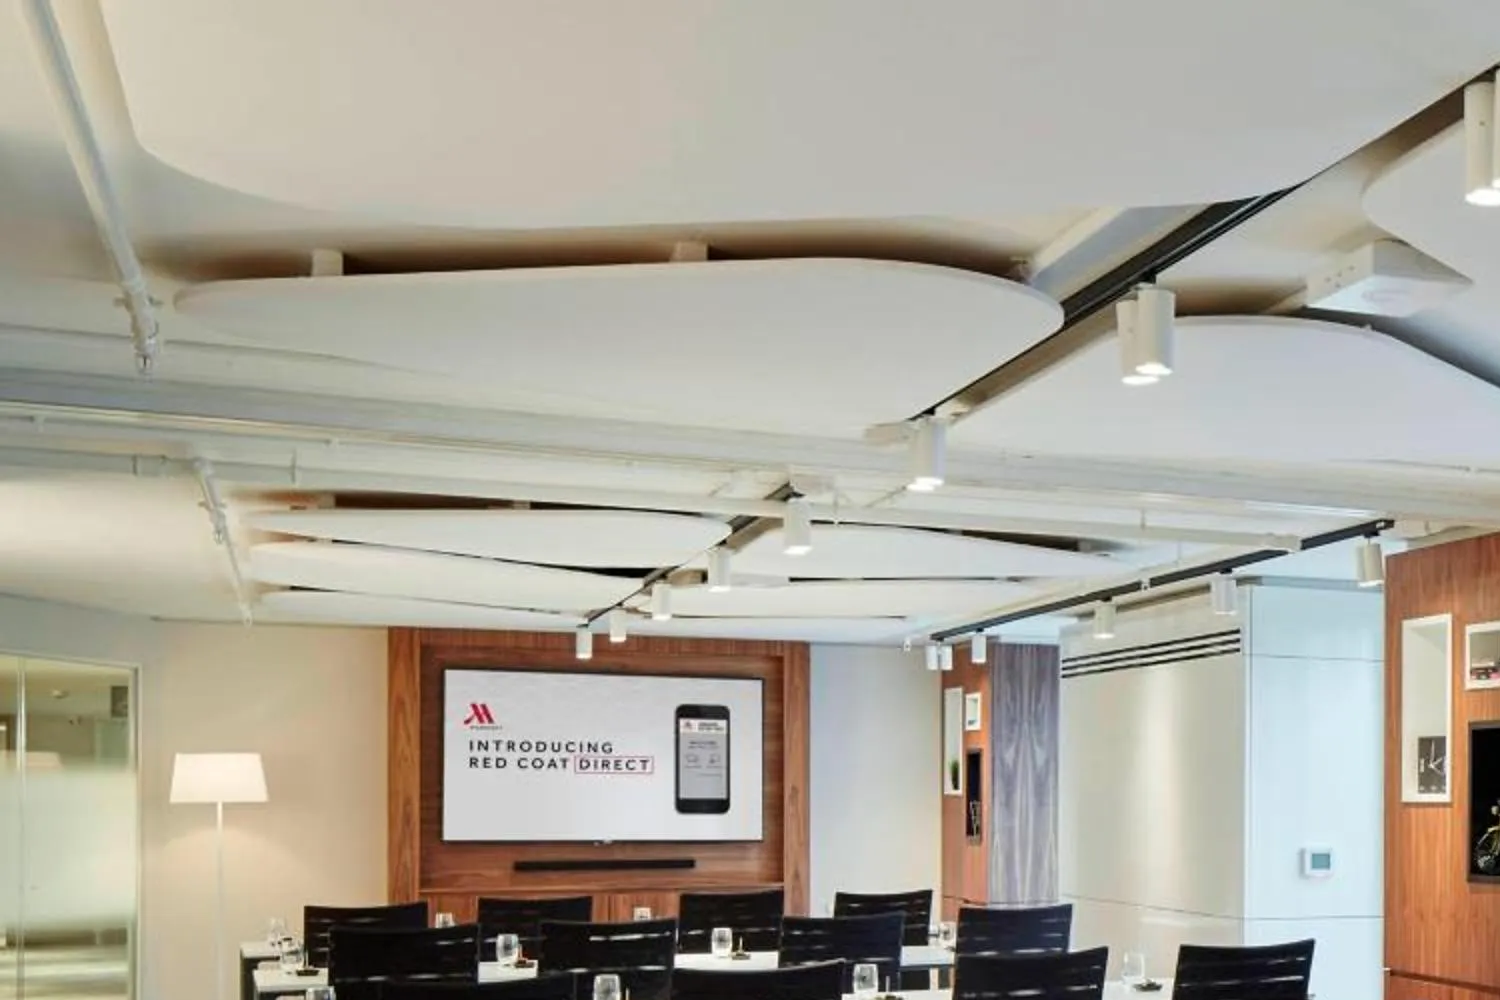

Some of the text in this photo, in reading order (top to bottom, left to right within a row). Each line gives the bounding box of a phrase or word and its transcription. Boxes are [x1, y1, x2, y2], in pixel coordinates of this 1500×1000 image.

[469, 739, 613, 754] INTRODUCING
[469, 757, 649, 771] RED COAT DIRECT
